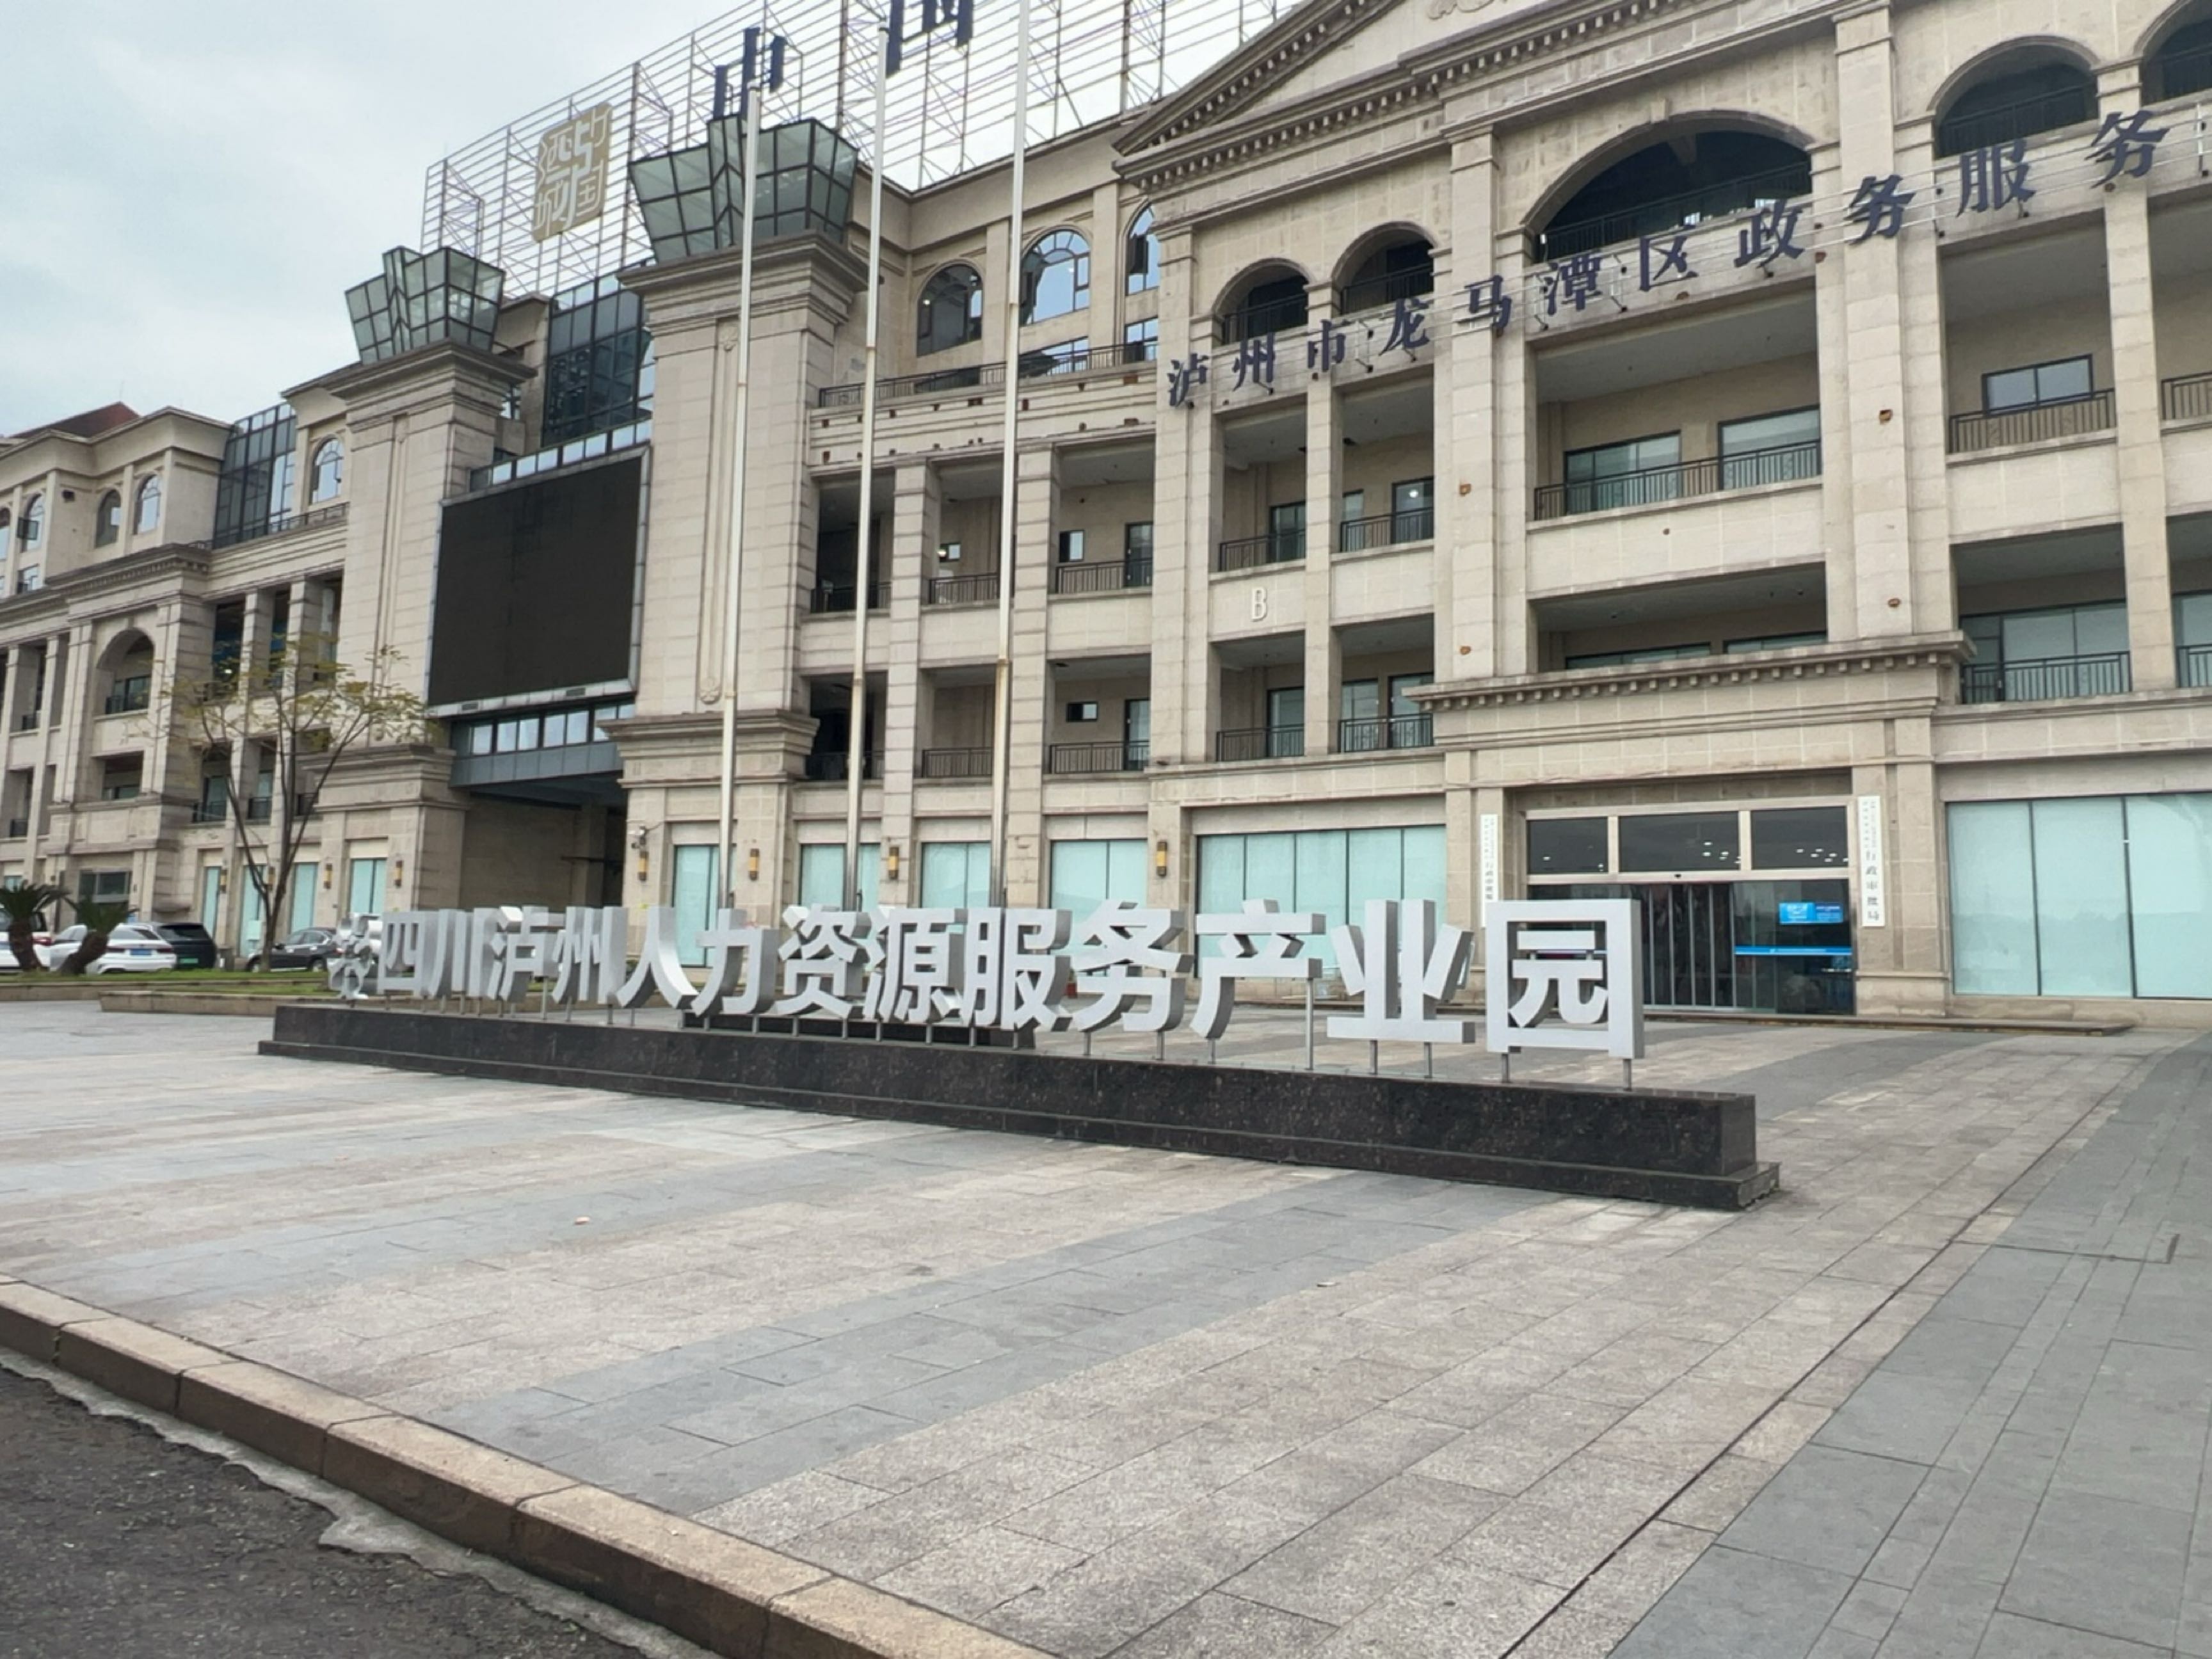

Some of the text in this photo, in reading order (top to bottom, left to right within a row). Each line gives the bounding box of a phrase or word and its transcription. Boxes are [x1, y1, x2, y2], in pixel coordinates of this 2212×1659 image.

[1167, 110, 2170, 407] 泸州市龙马潭区政务服务
[1251, 586, 1268, 622] B
[377, 899, 1644, 1059] 四川泸州人力资源服务产业园
